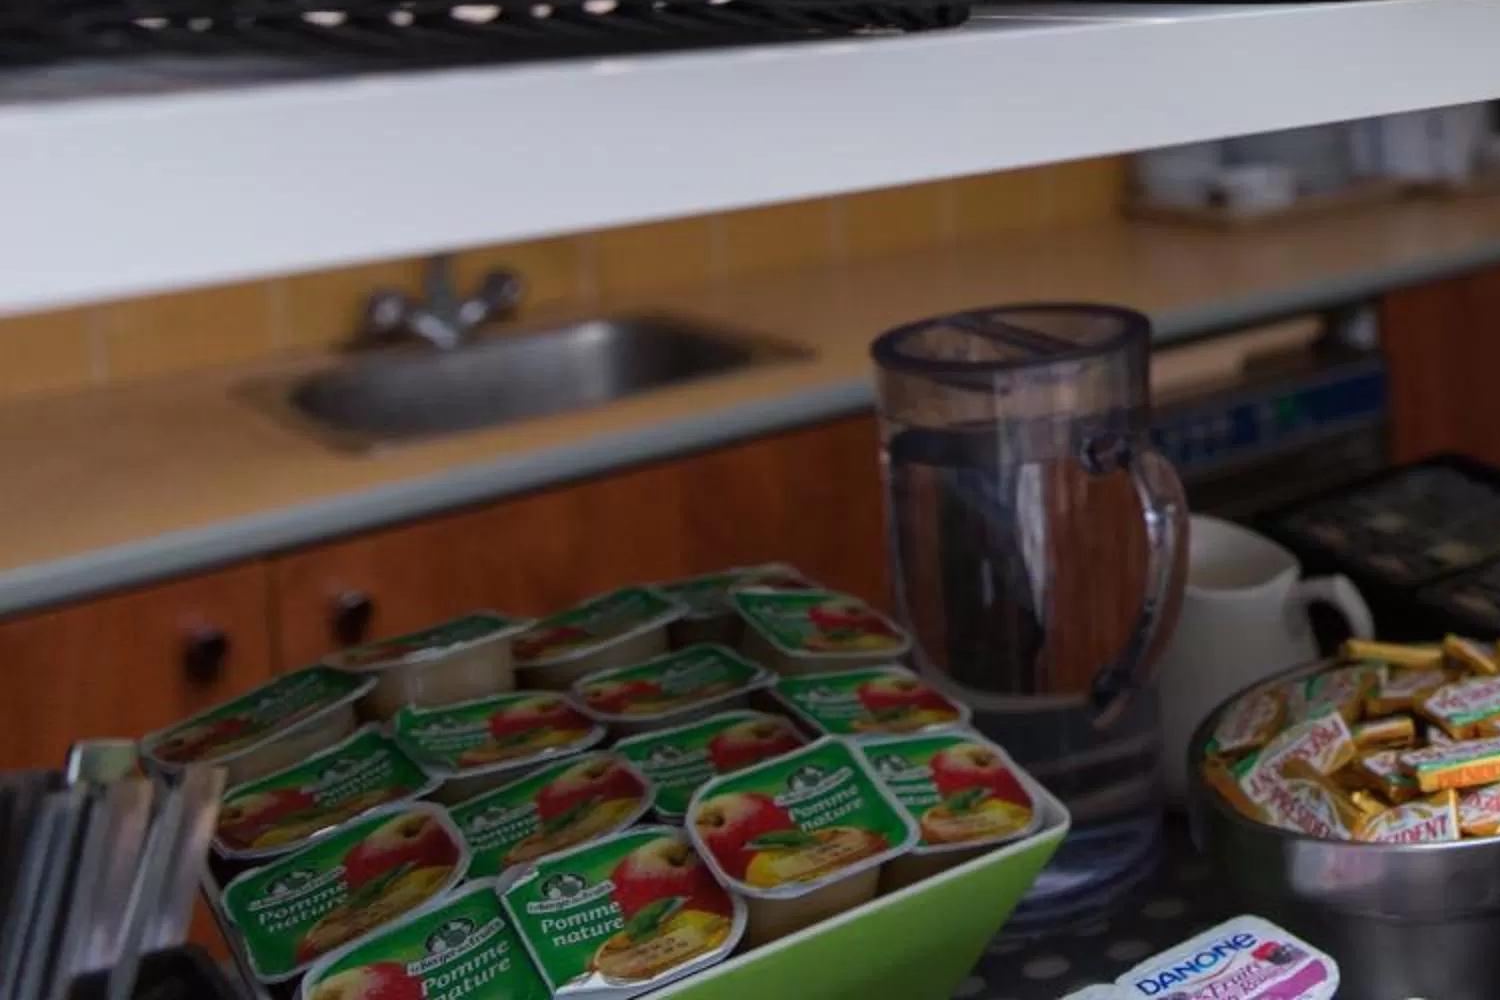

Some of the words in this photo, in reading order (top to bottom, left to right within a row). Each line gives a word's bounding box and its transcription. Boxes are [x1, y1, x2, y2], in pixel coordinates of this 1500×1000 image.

[541, 901, 623, 934] Pomme
[552, 915, 625, 948] nature
[420, 939, 510, 997] Pomme
